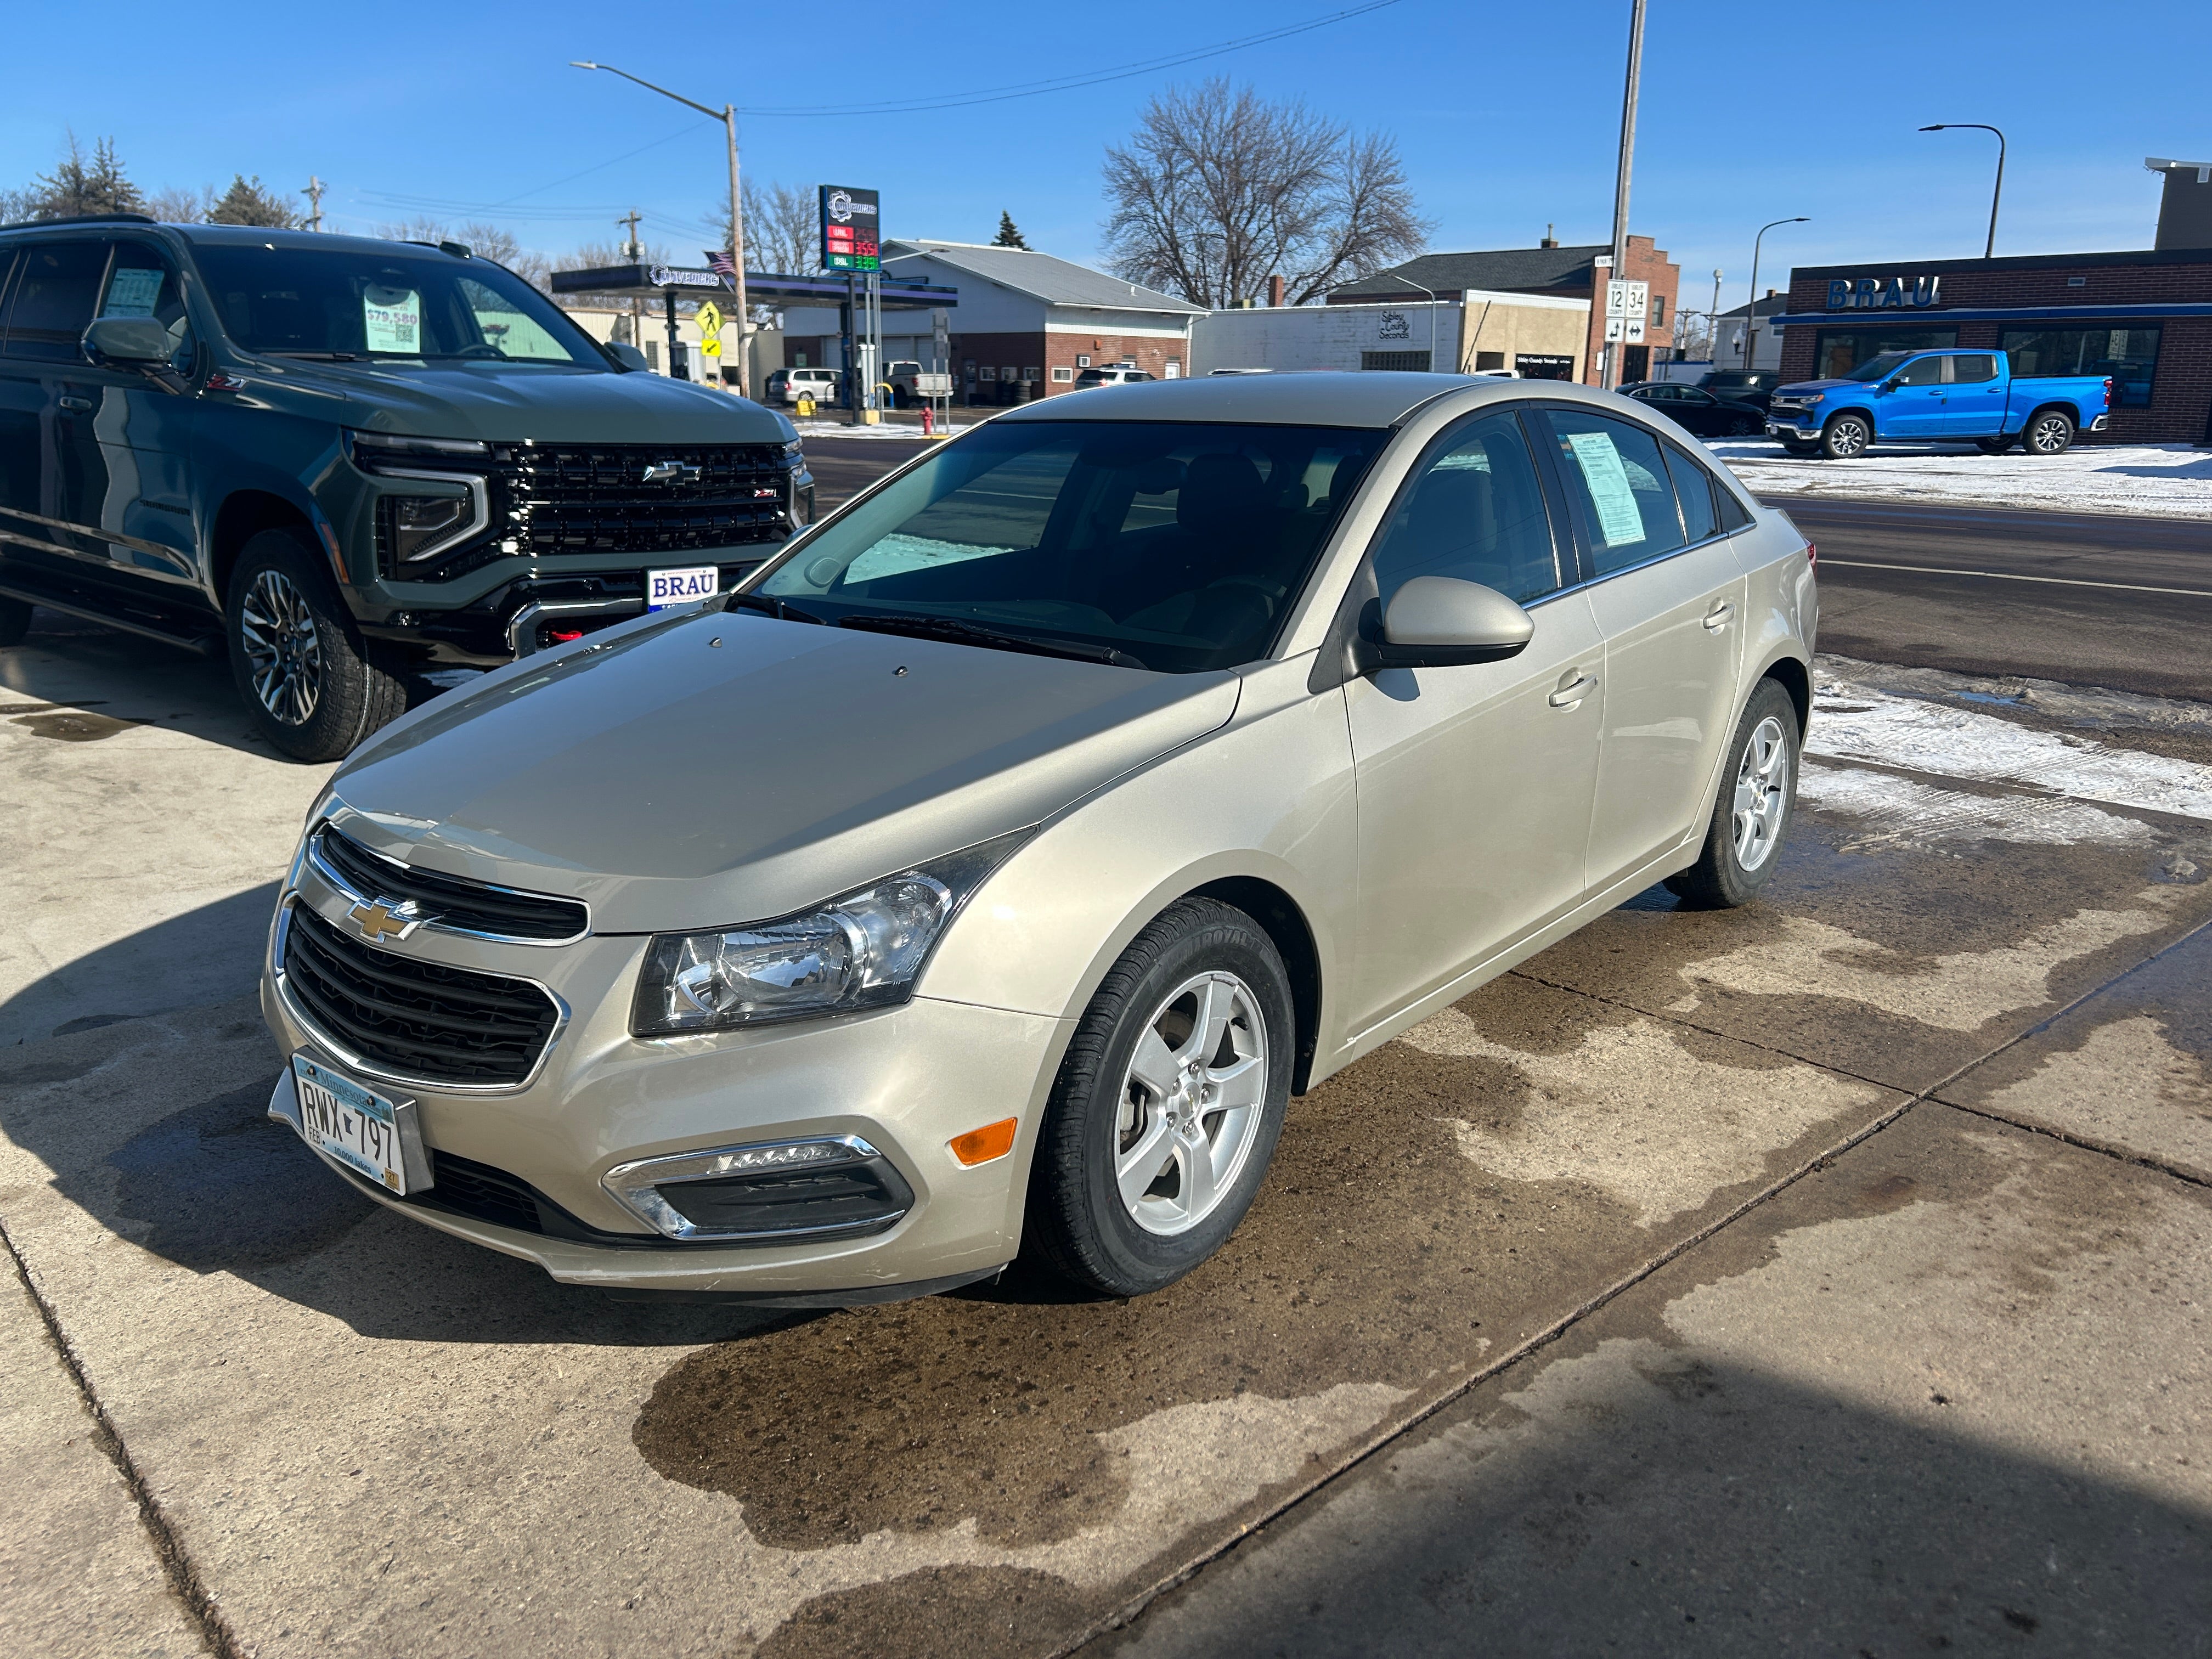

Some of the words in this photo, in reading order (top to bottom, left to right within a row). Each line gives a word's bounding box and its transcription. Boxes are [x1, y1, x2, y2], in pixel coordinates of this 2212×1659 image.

[1611, 291, 1622, 307] 12
[1629, 292, 1644, 308] 34
[1826, 276, 1938, 309] BRAU
[1381, 311, 1406, 324] Sibley
[1379, 328, 1409, 339] Seconds
[653, 574, 714, 599] BRAU
[320, 1070, 367, 1104] Minnesota
[302, 1081, 343, 1142] RWX
[354, 1108, 392, 1169] 797
[308, 1126, 321, 1144] FEB
[354, 1158, 372, 1173] lakes
[388, 1171, 395, 1182] 27
